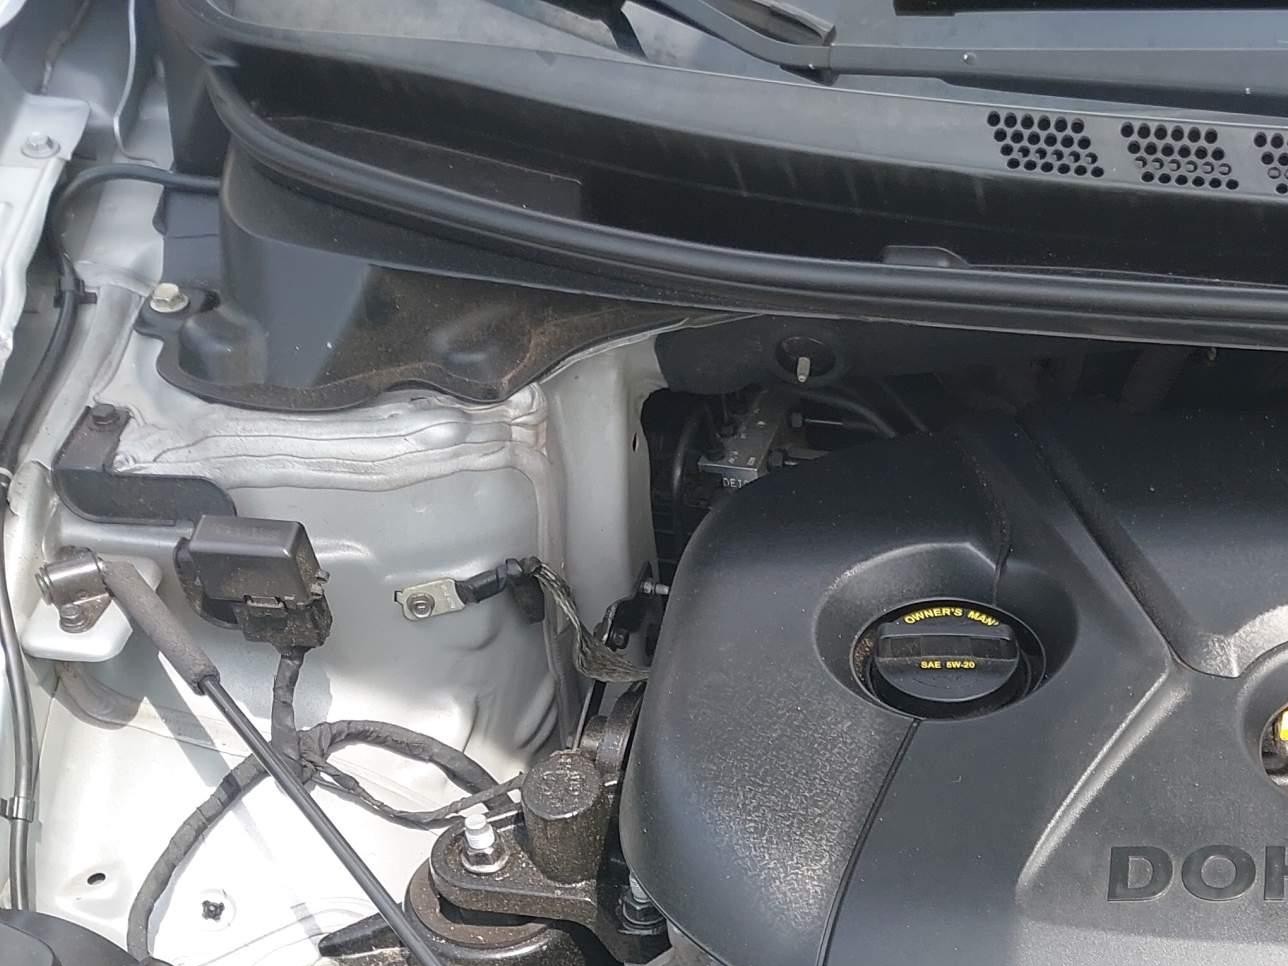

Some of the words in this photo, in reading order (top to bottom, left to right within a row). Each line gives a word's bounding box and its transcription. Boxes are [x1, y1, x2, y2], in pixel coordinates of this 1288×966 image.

[904, 607, 963, 625] OWNER'S
[920, 660, 942, 670] SAE
[946, 660, 976, 670] 5W-20
